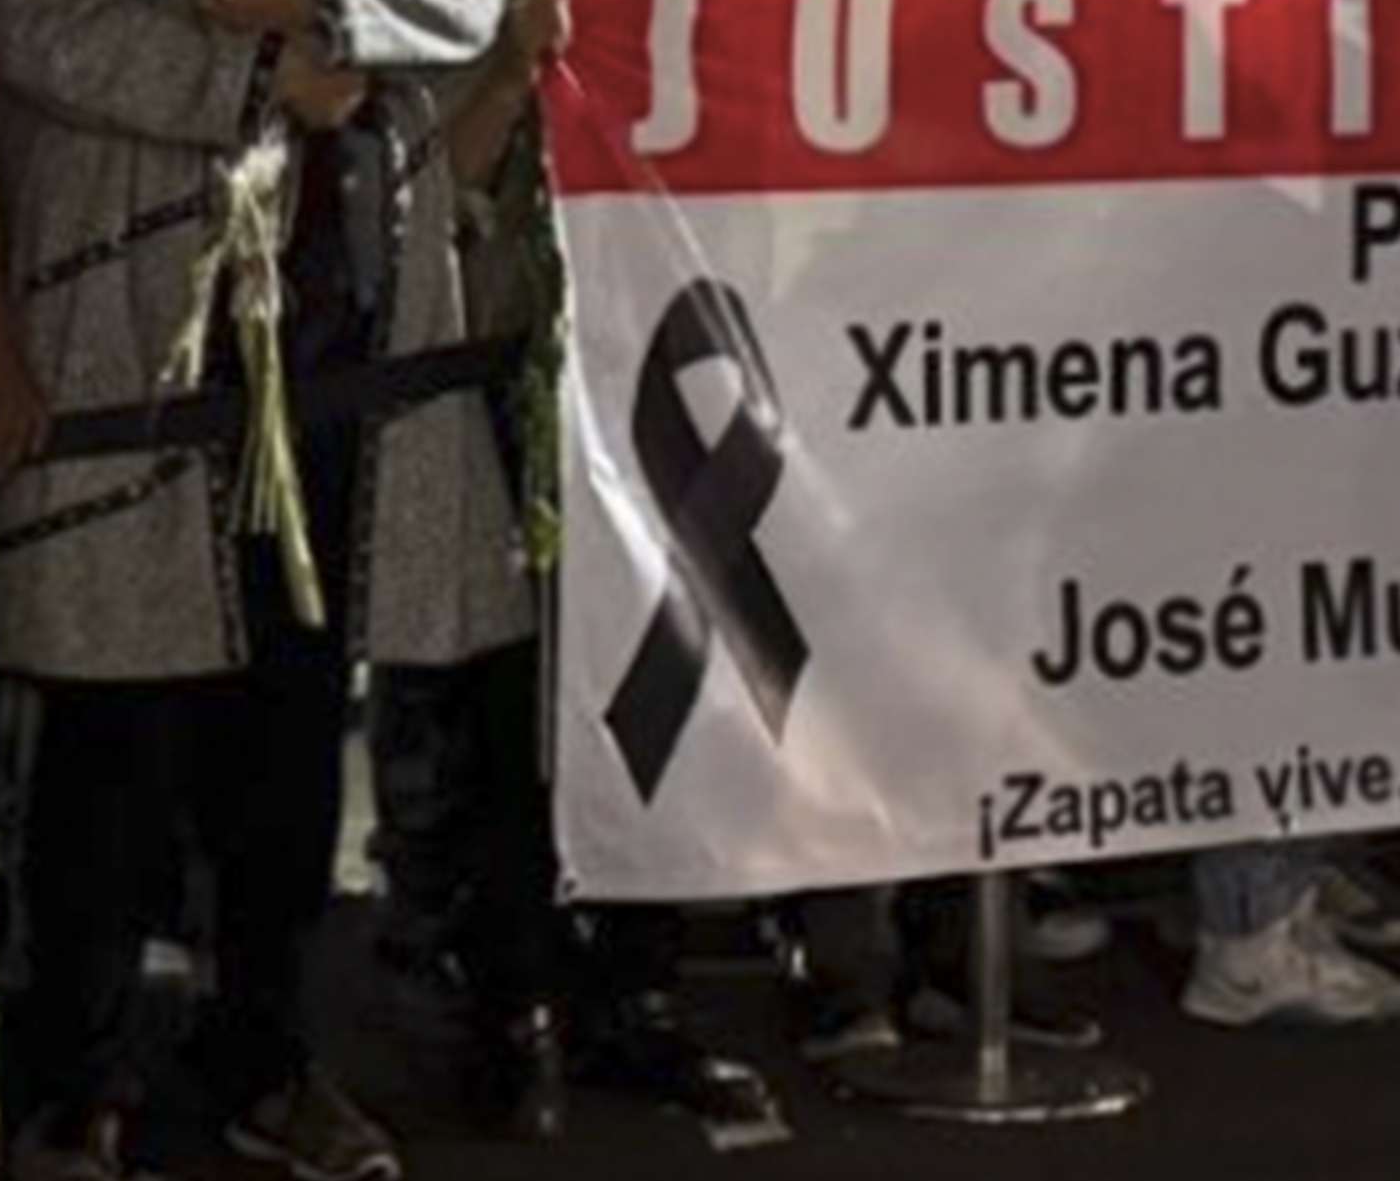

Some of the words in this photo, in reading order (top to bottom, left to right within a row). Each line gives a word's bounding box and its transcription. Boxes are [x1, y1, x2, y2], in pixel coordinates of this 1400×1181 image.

[845, 319, 1222, 431] Ximena
[1031, 564, 1267, 686] José
[977, 759, 1236, 861] ¡Zapata
